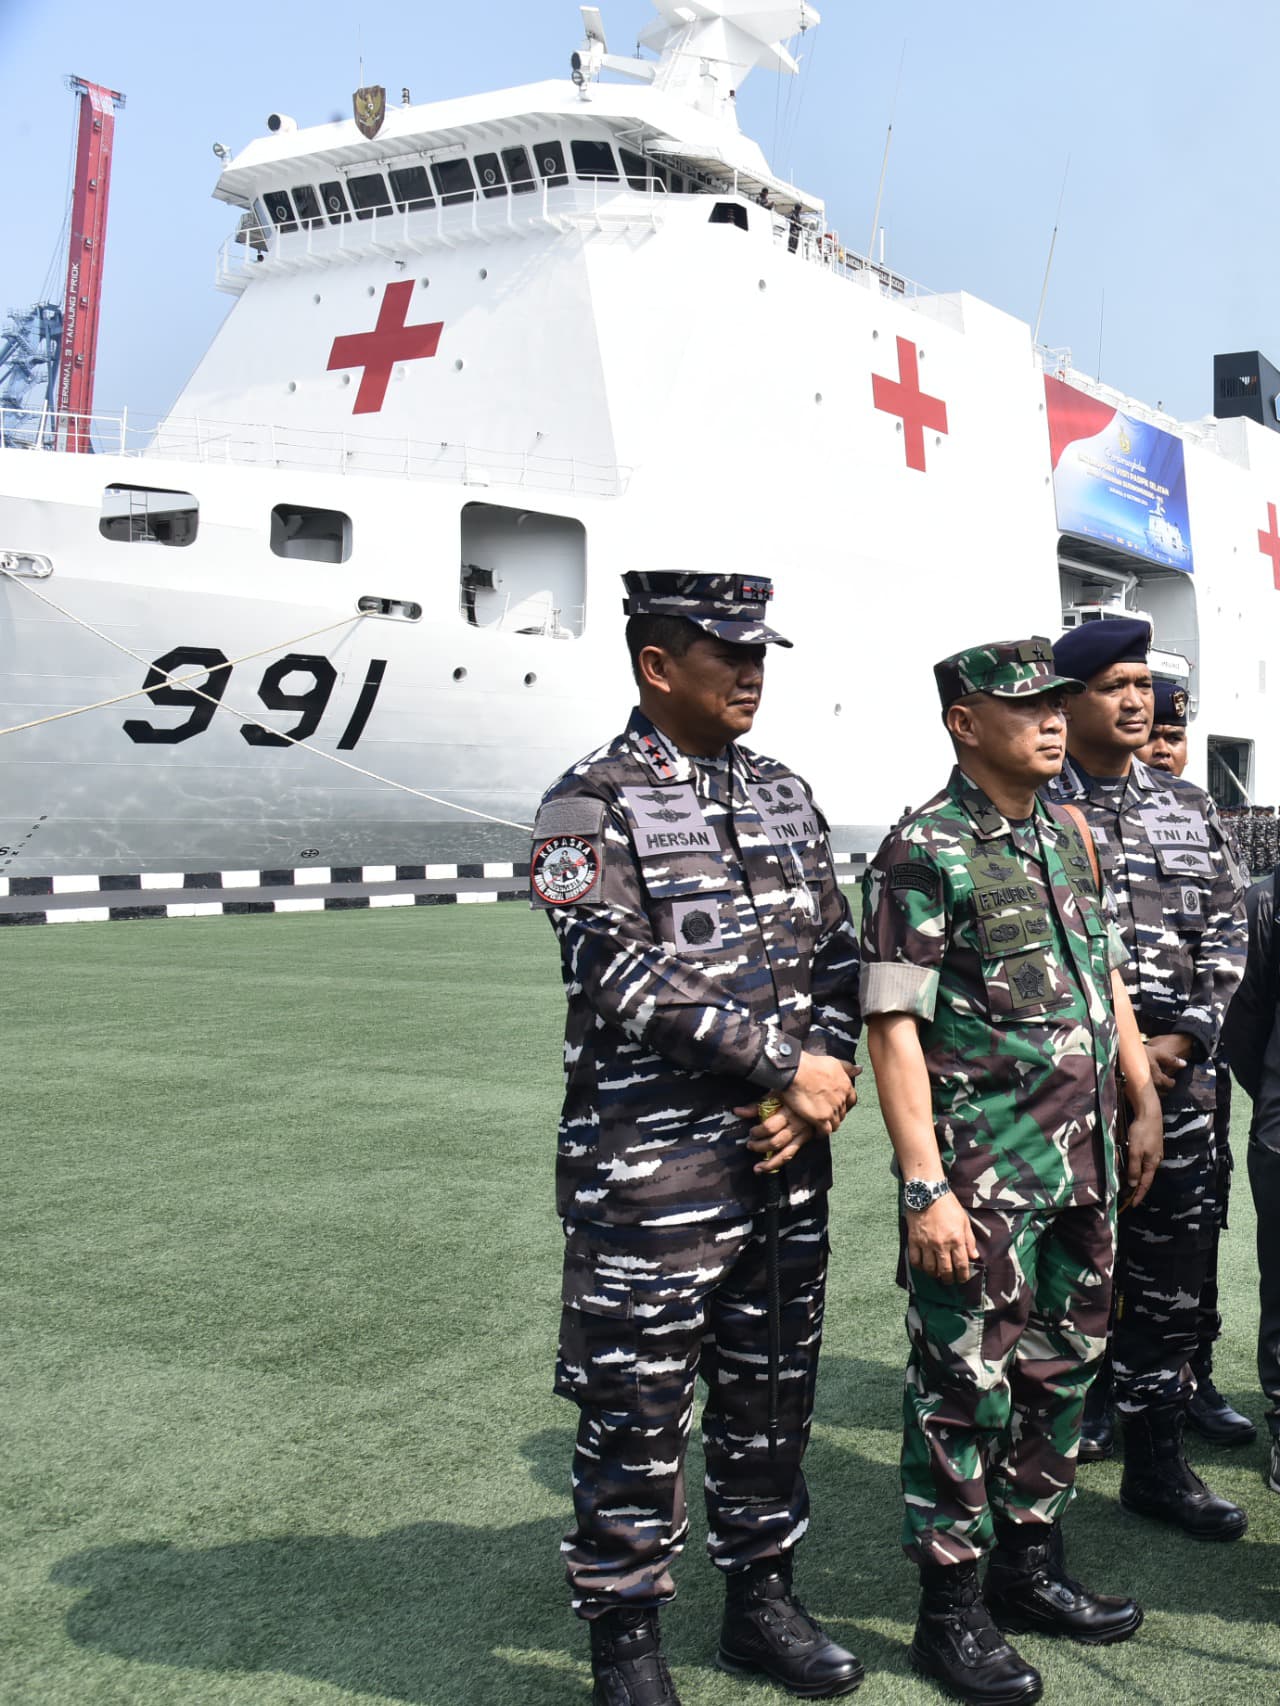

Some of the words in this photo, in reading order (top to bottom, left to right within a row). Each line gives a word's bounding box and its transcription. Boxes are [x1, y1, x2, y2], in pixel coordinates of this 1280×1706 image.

[70, 263, 80, 294] PRIOK
[66, 296, 76, 344] TANJUNG
[62, 362, 72, 408] TERMINAL
[122, 646, 388, 750] 991
[646, 832, 710, 848] HERSAN
[771, 823, 798, 839] TNI
[802, 821, 816, 836] AL
[1152, 830, 1180, 840] TNI
[1186, 831, 1204, 842] AL
[539, 838, 591, 858] KOPASKA
